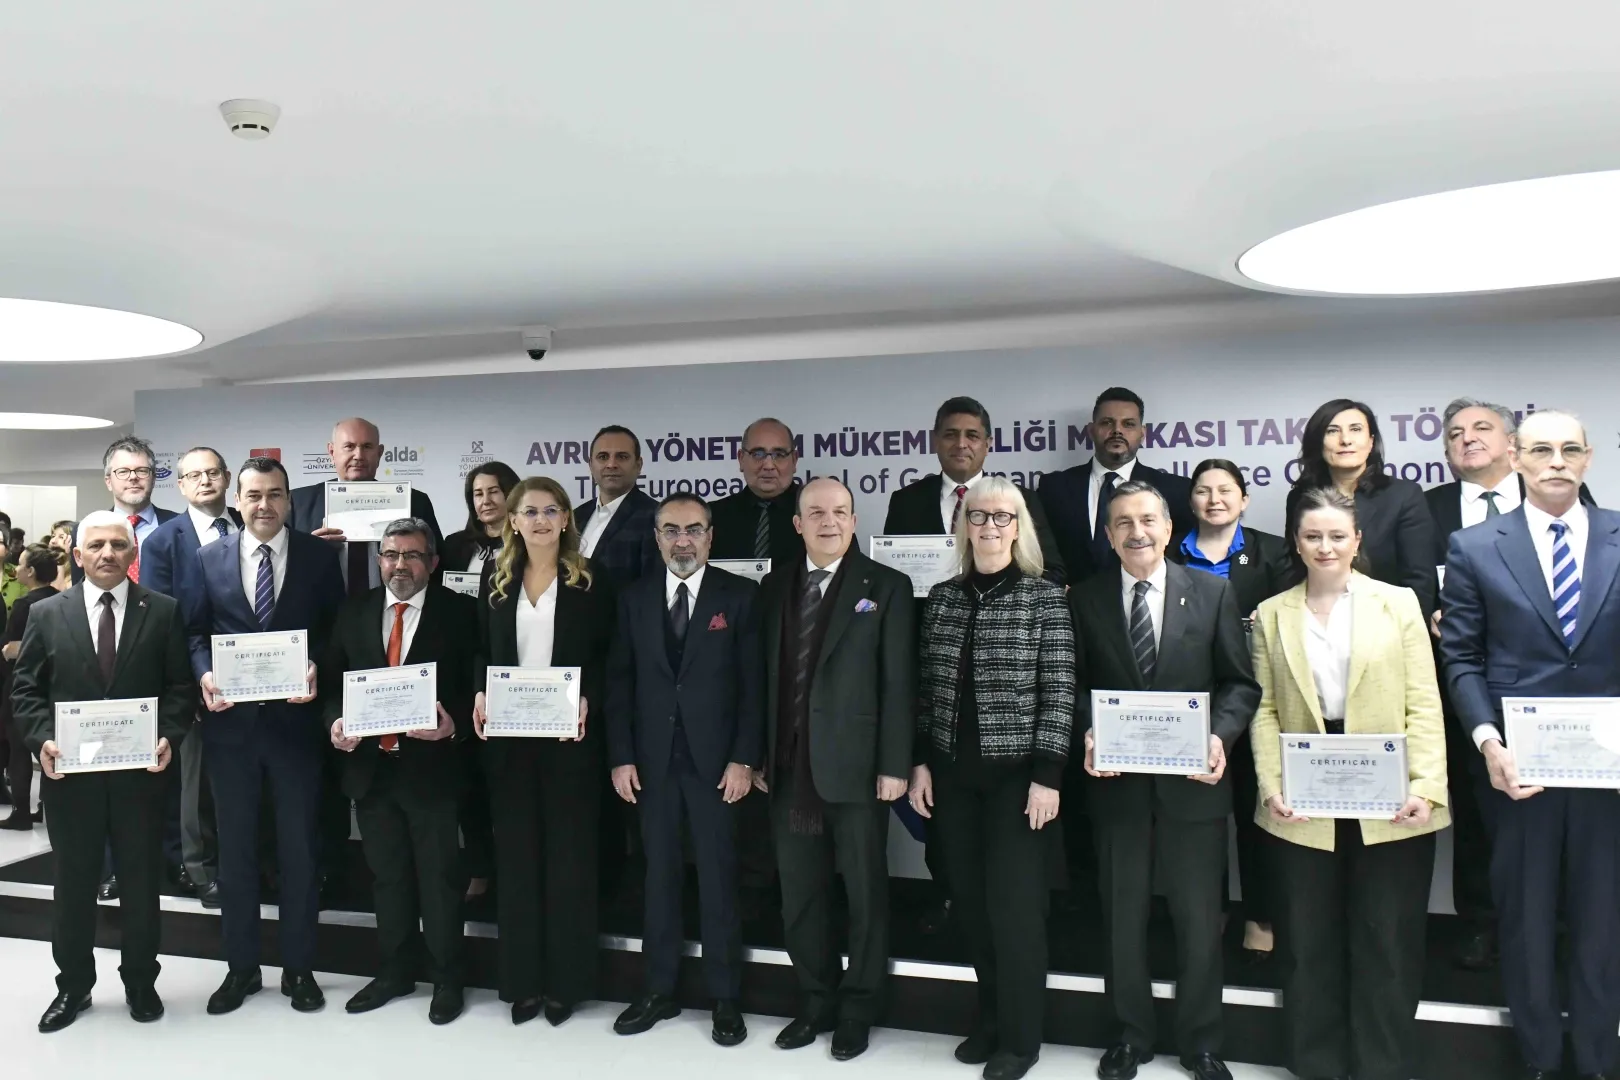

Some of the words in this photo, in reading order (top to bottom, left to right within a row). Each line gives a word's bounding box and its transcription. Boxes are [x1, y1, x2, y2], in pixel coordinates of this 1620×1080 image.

[526, 441, 591, 465] AVR
[814, 420, 1056, 458] MÜKEMLİĞİ
[1067, 420, 1226, 451] MKASI
[384, 446, 418, 463] alda
[637, 473, 744, 499] uropea
[859, 467, 889, 494] of
[234, 650, 286, 659] CERTIFICATE
[365, 684, 415, 694] CERTIFICATE
[1119, 714, 1182, 723] CERTIFICATE
[79, 719, 134, 728] CERTIFICATE
[1538, 724, 1592, 732] CERTIFIC
